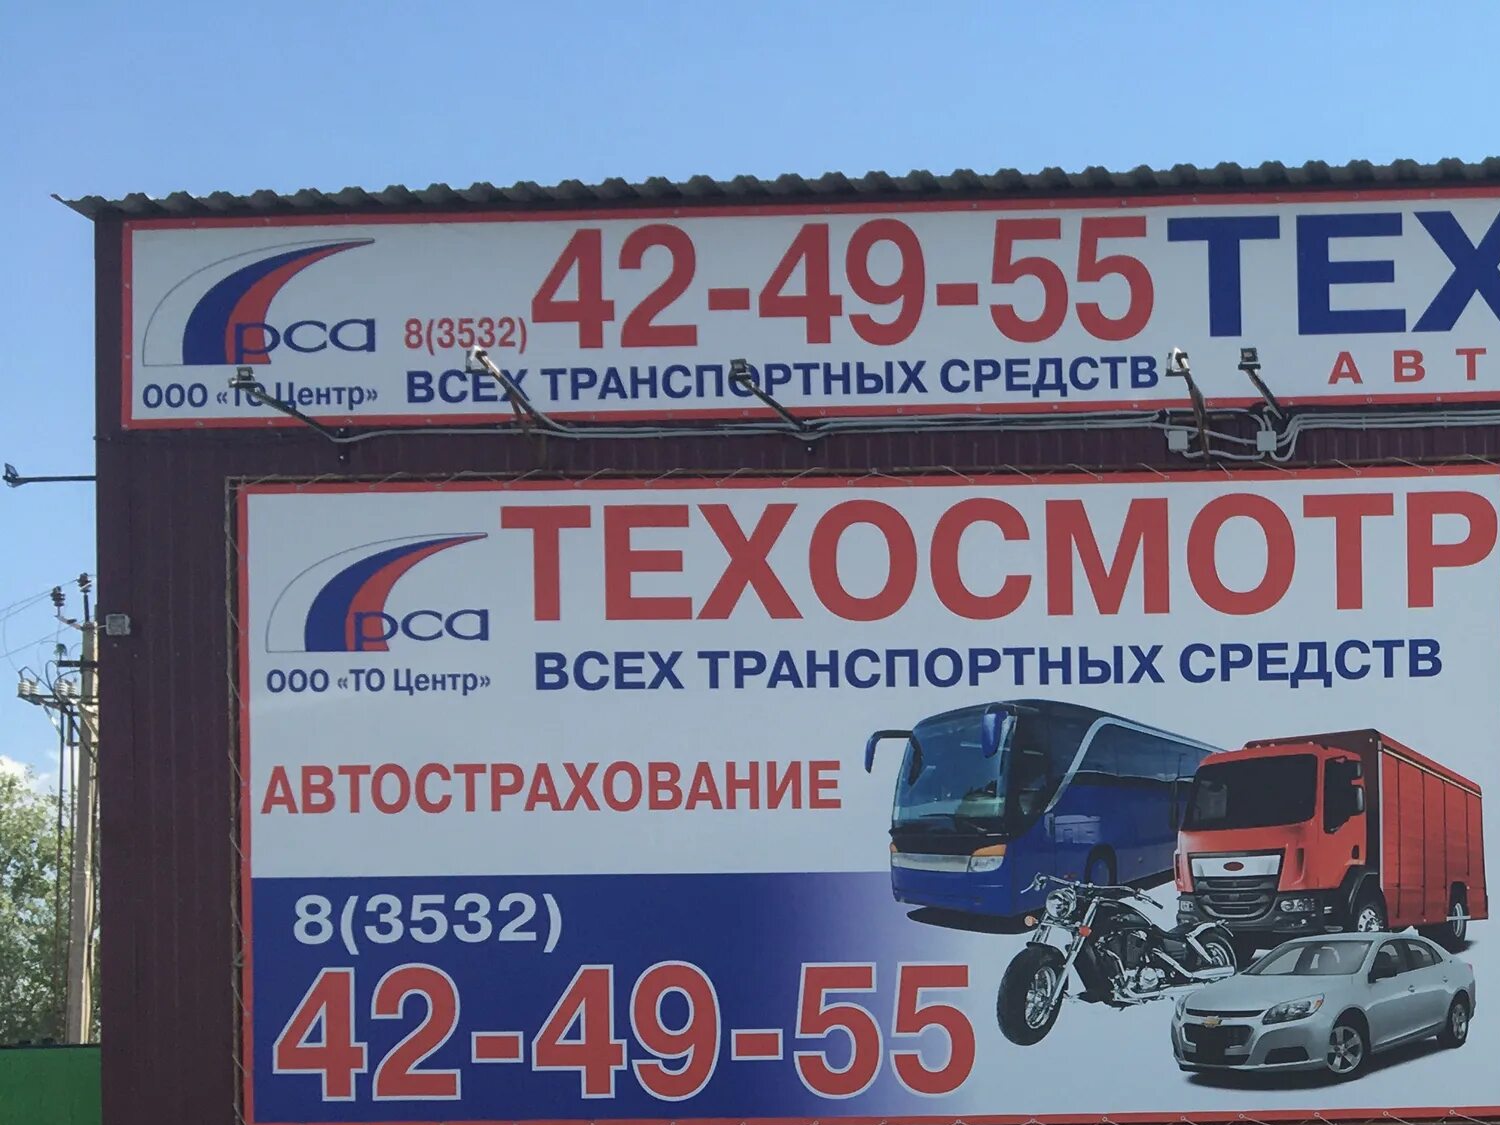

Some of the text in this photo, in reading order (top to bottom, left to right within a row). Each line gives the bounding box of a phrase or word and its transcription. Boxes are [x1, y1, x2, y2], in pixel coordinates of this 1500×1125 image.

[404, 215, 1155, 356] 8(3532) 42-49-55
[142, 382, 208, 409] ООО
[275, 381, 378, 411] Центр»
[406, 355, 1159, 404] ВСЕХ ТРАНСПОРТНЫХ СРЕДСТВ
[500, 490, 1498, 622] ТЕХОСМОТР
[266, 668, 330, 693] ООО
[393, 667, 491, 696] Центр»
[534, 637, 1443, 691] ВСЕХ ТРАНСПОРТНЫХ СРЕДСТВ
[260, 759, 842, 815] АВТОСТРАХОВАНИЕ
[293, 892, 562, 955] 8(3532)
[271, 959, 977, 1102] 42-49-55
